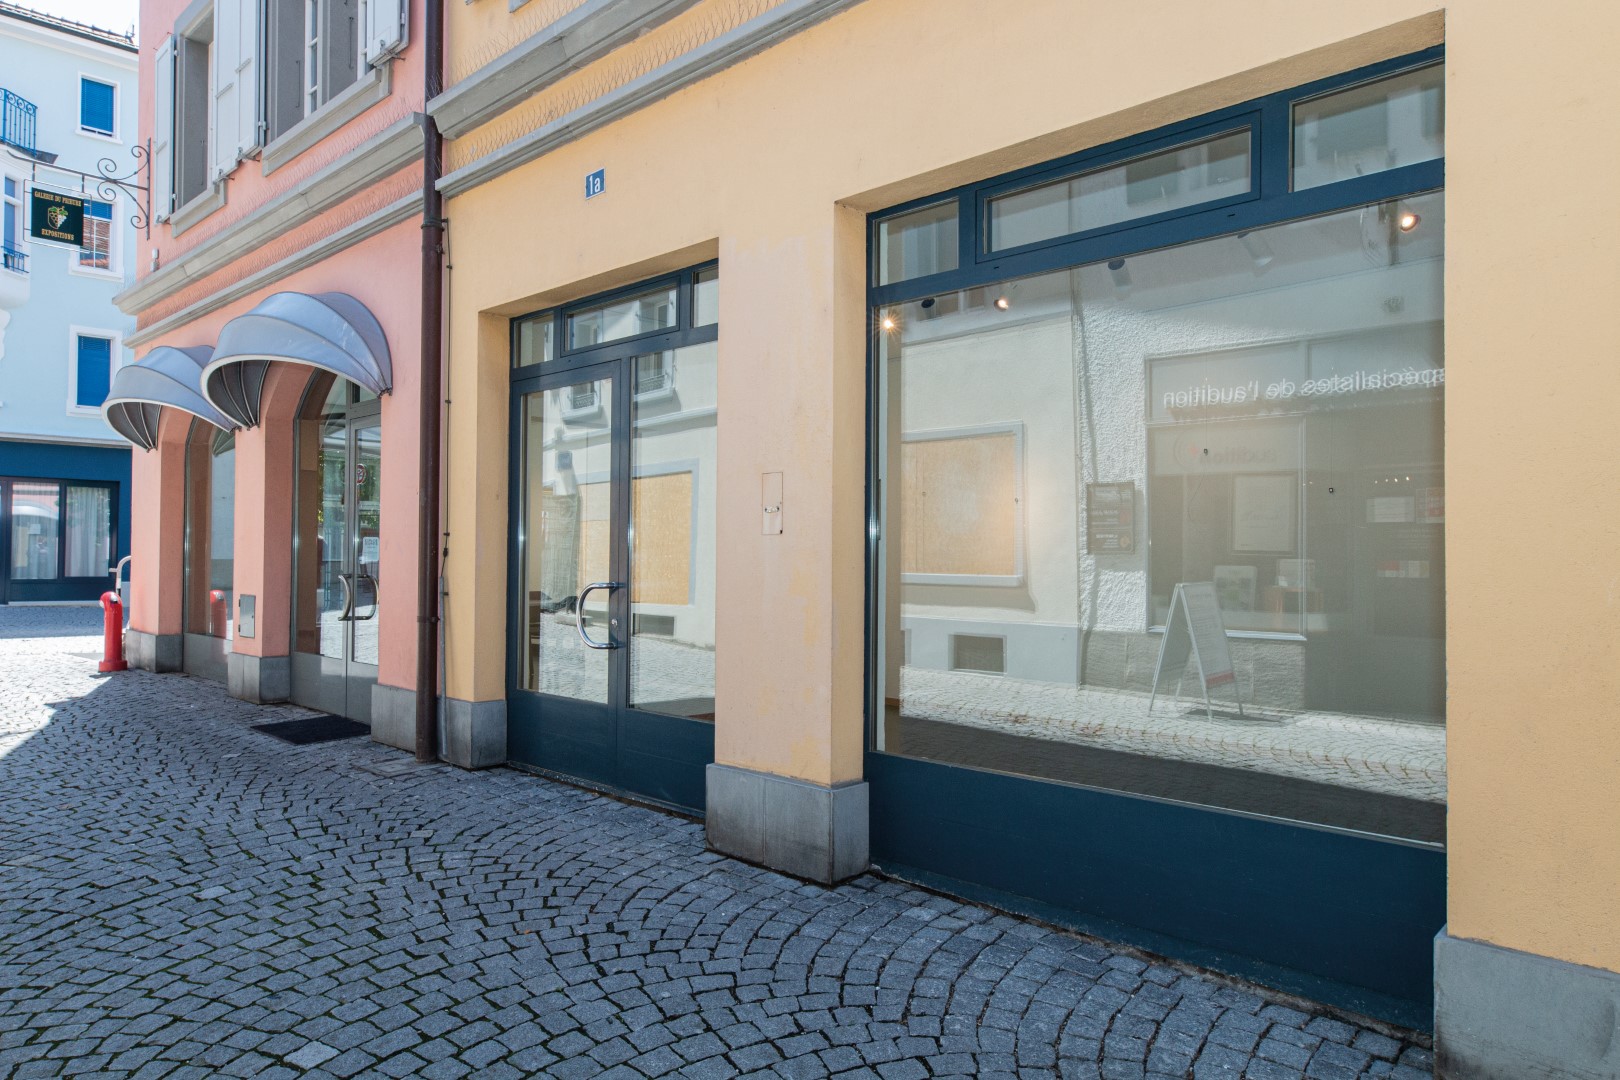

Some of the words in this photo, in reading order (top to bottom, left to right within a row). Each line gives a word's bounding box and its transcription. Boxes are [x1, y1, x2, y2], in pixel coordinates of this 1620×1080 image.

[589, 175, 601, 195] 1a
[34, 191, 54, 201] GALERIE
[54, 195, 61, 203] DU
[41, 228, 74, 240] EXPOSITIONS
